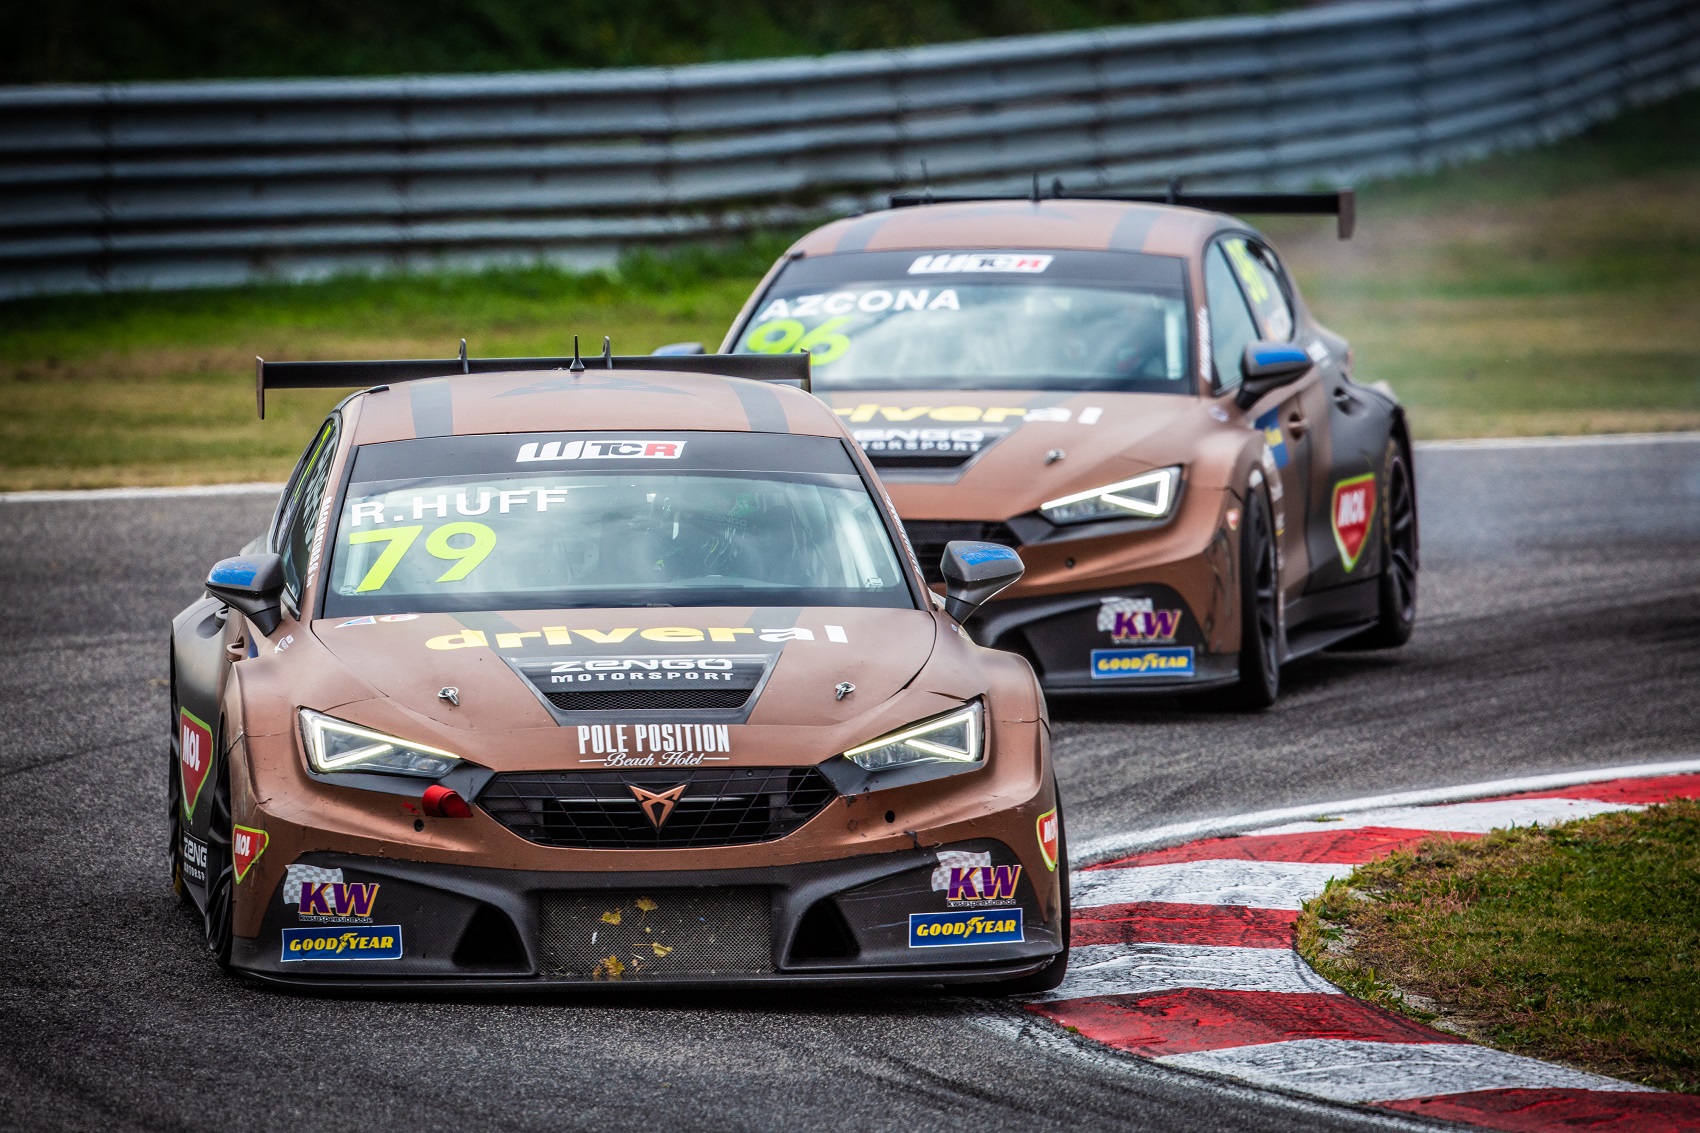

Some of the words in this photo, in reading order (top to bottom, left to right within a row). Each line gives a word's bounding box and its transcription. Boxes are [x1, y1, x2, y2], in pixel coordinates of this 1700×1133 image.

[759, 289, 960, 322] AZCONA
[746, 316, 852, 367] 96
[516, 441, 688, 463] WTCR
[351, 489, 568, 527] R.HUFF
[349, 521, 497, 593] 79
[1111, 609, 1183, 640] KW
[551, 672, 734, 683] MOTORSPORT
[1097, 653, 1188, 672] GOODYEAR
[182, 724, 201, 772] MOL
[577, 724, 629, 754] POLE
[635, 723, 730, 752] POSITION
[603, 751, 655, 767] Beach
[658, 750, 704, 766] Hotel
[234, 833, 251, 857] MOL
[1043, 817, 1058, 844] MO
[183, 836, 208, 869] ZENG
[946, 865, 1022, 900] KW
[298, 881, 380, 917] KW
[916, 916, 1017, 939] GOODYEAR
[289, 932, 394, 955] GOODYEAR
